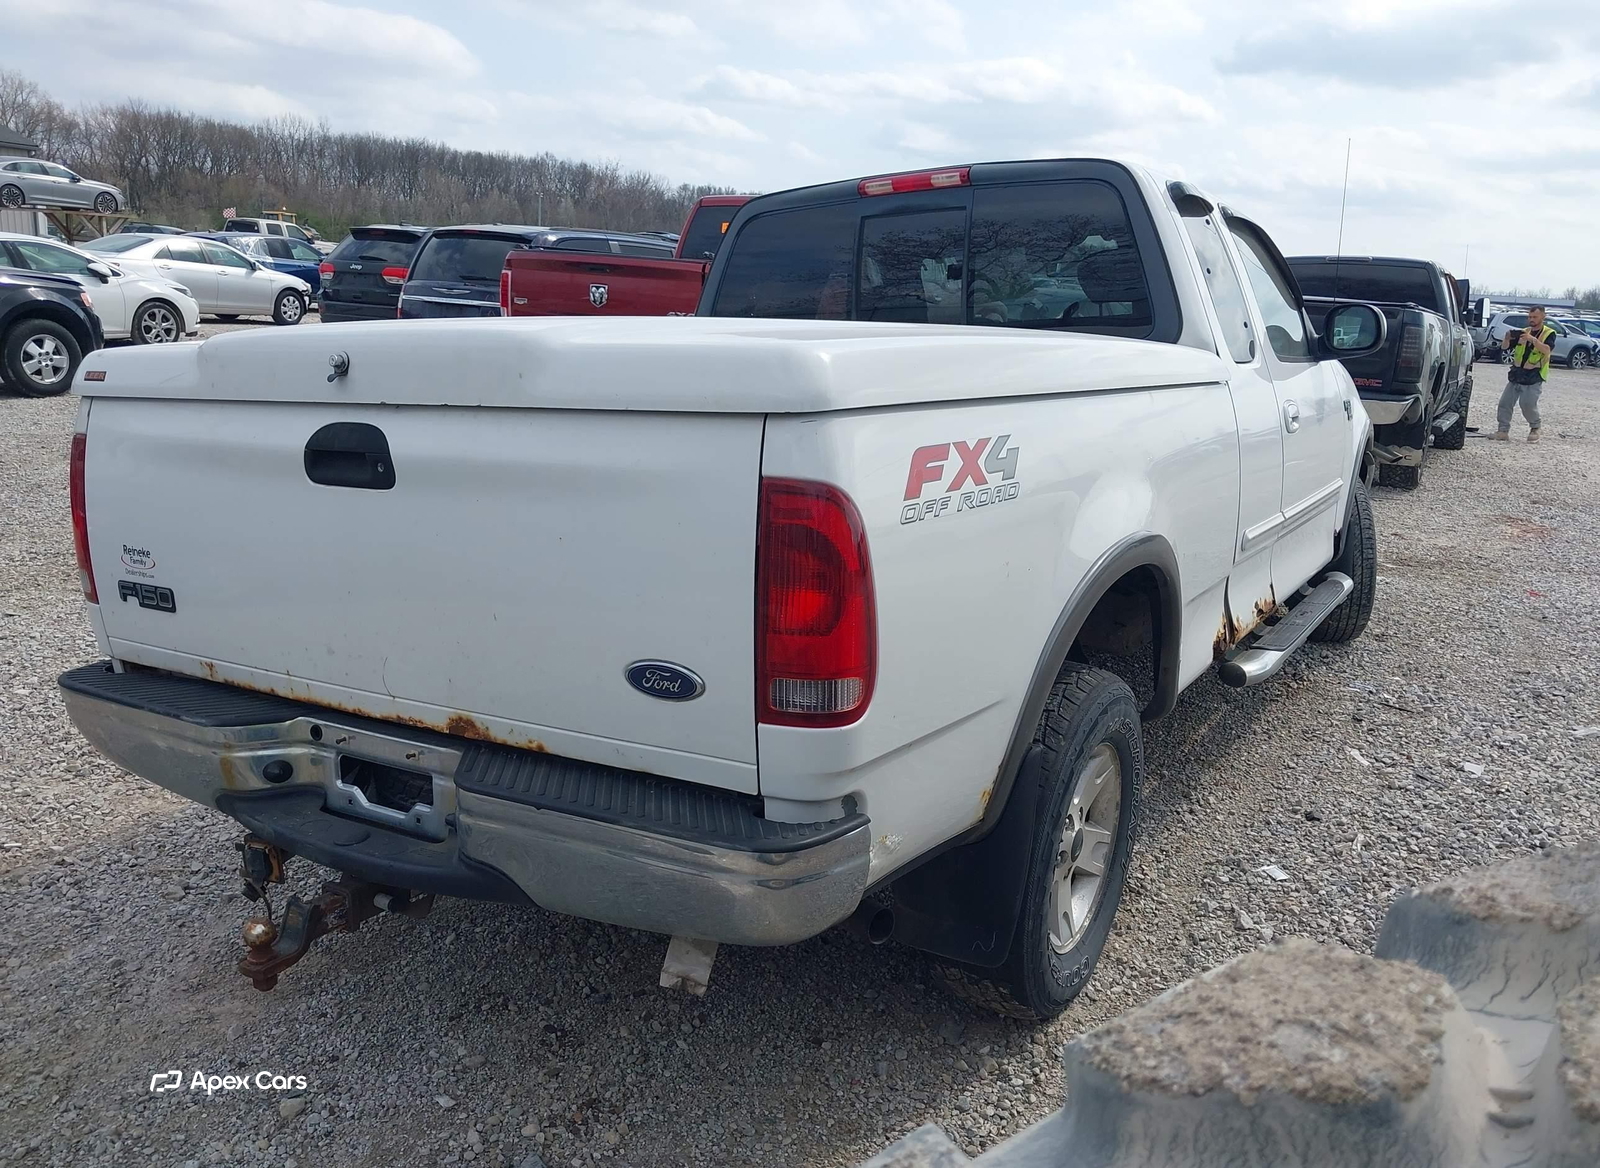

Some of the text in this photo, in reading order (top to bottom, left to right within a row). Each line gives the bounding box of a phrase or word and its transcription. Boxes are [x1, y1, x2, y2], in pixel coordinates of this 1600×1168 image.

[349, 263, 363, 271] Jeep
[85, 371, 106, 380] LEER
[1353, 377, 1383, 387] GMC
[903, 434, 1020, 501] FX4
[900, 481, 1020, 525] OFF ROAD
[122, 544, 151, 559] Reineke
[129, 556, 147, 567] Family
[642, 668, 682, 693] Ford
